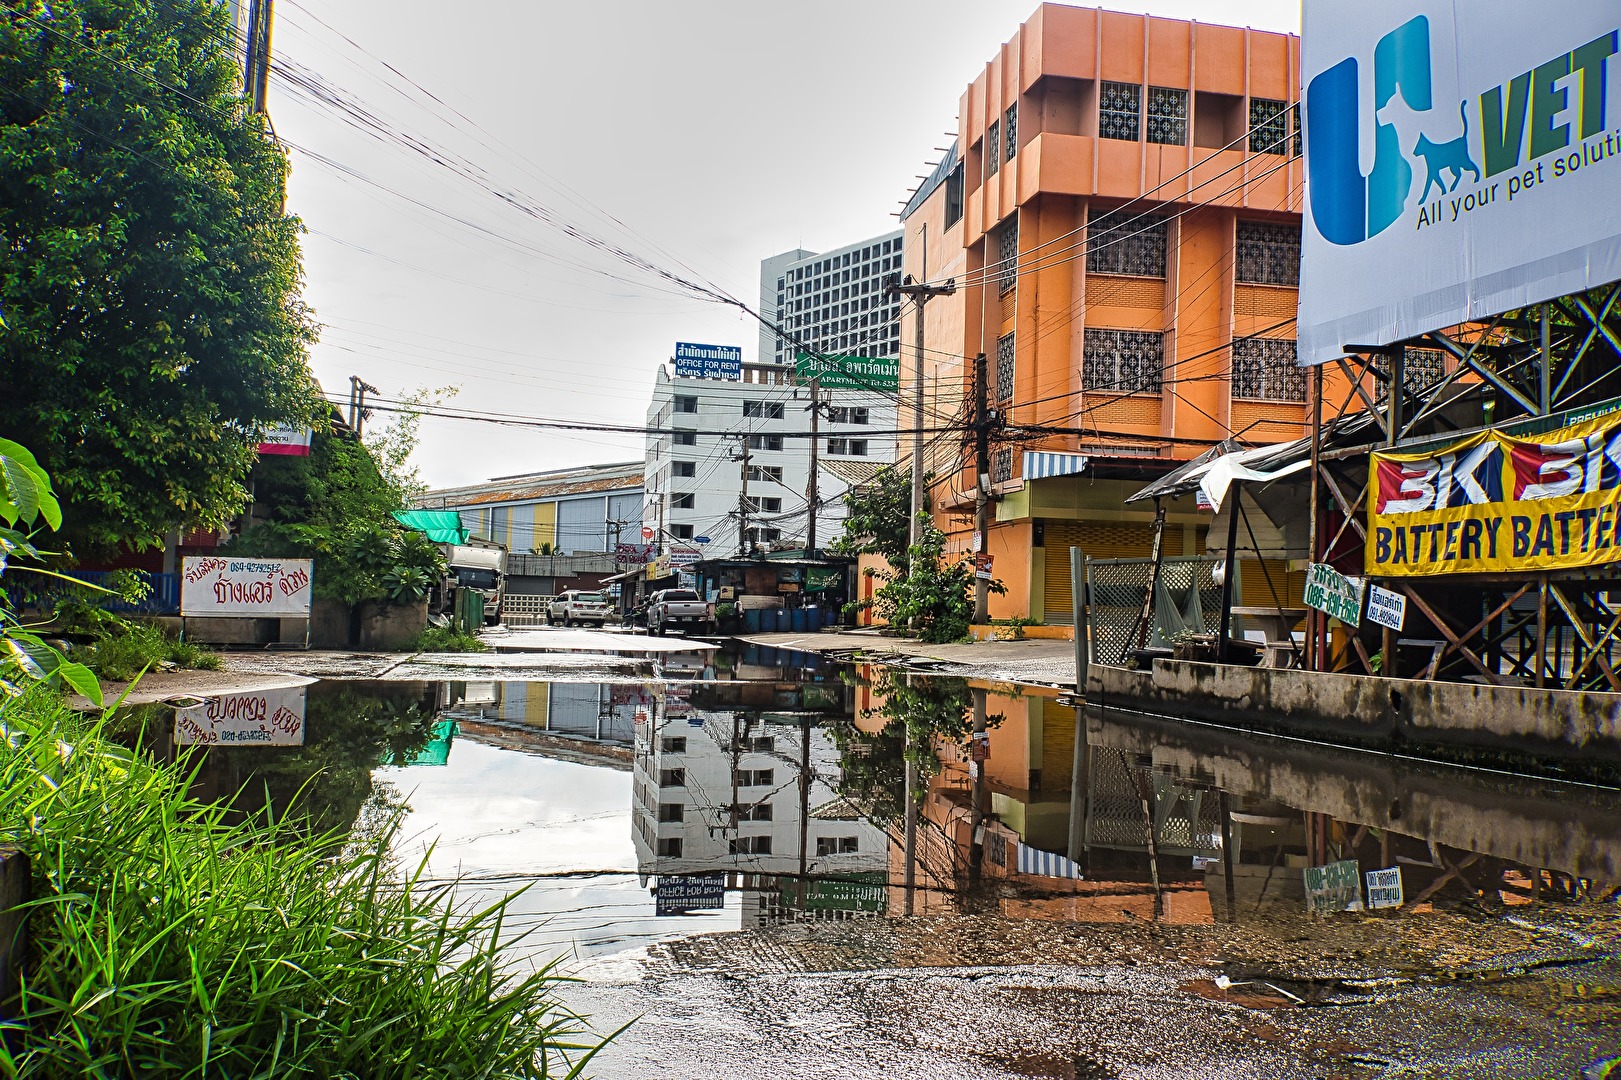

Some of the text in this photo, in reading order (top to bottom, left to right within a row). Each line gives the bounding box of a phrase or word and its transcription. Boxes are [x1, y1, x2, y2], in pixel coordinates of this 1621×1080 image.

[1479, 28, 1619, 179] VET
[1416, 199, 1442, 231] All
[1450, 182, 1499, 222] your
[1508, 161, 1544, 201] pet
[677, 359, 740, 371] OFFICE FOR RENT
[677, 367, 702, 377] บริการ
[1376, 517, 1503, 565] BATTERY
